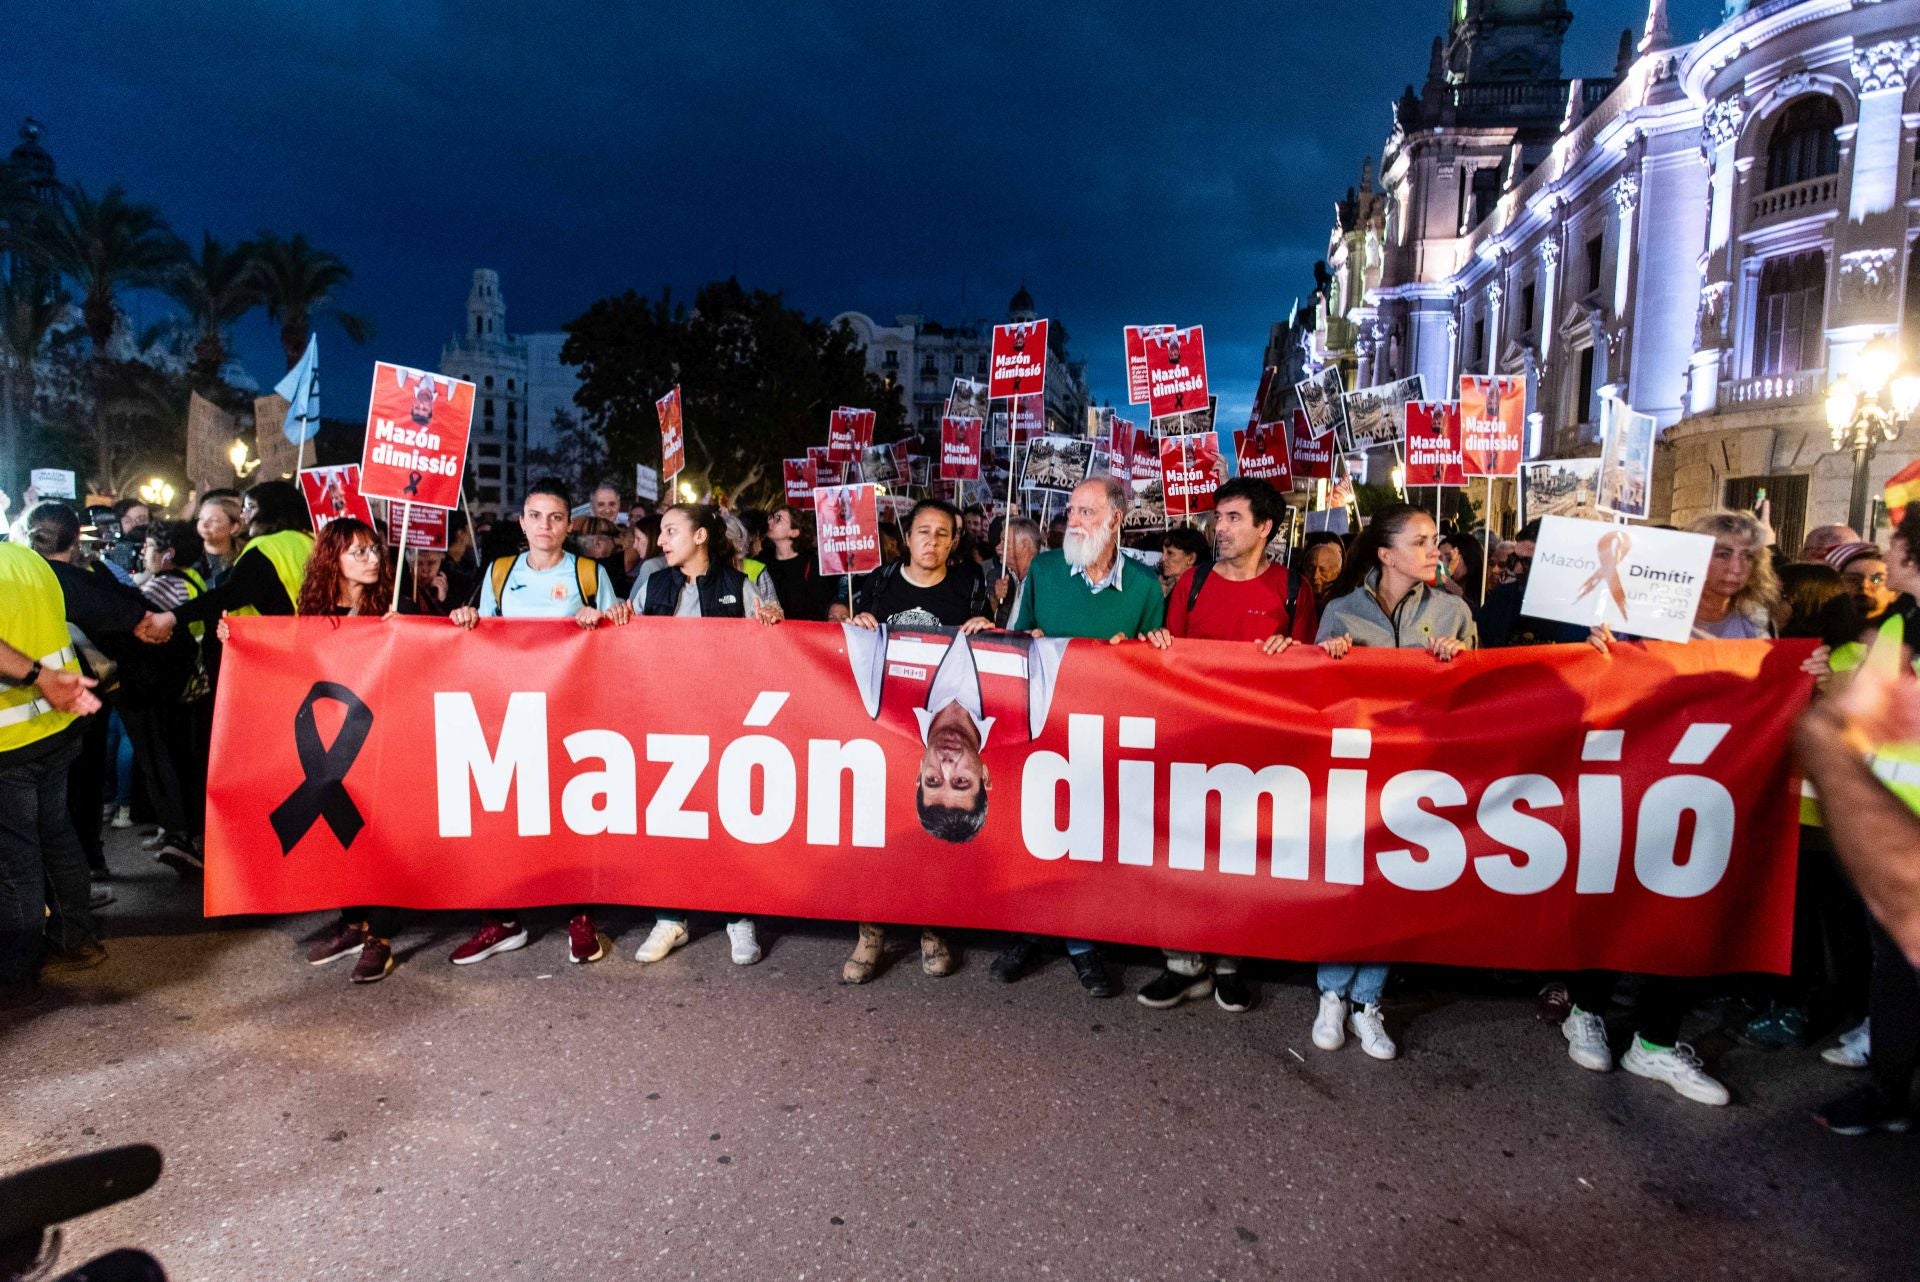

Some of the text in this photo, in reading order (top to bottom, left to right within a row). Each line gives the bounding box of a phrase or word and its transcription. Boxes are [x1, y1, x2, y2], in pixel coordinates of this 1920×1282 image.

[995, 352, 1031, 367] Mazón
[994, 363, 1042, 380] dimissió
[1151, 364, 1190, 383] Mazón
[1152, 375, 1204, 398] dimissió
[1465, 416, 1507, 433] Mazón
[375, 418, 441, 451] Mazón
[1295, 437, 1321, 447] Mazón
[1410, 433, 1451, 449] Mazón
[1465, 434, 1519, 451] dimissió
[944, 443, 970, 455] Mazón
[1293, 450, 1329, 463] dimissió
[372, 443, 458, 477] dimissió
[944, 455, 978, 466] dimissió
[1241, 453, 1275, 470] Mazón
[787, 480, 808, 489] Mazón
[822, 523, 861, 538] Mazón
[823, 536, 875, 553] dimissió
[1540, 551, 1596, 571] Mazón
[1629, 564, 1695, 585] Dimítir
[1627, 591, 1648, 601] un
[434, 691, 1736, 898] Mazón dimissió
